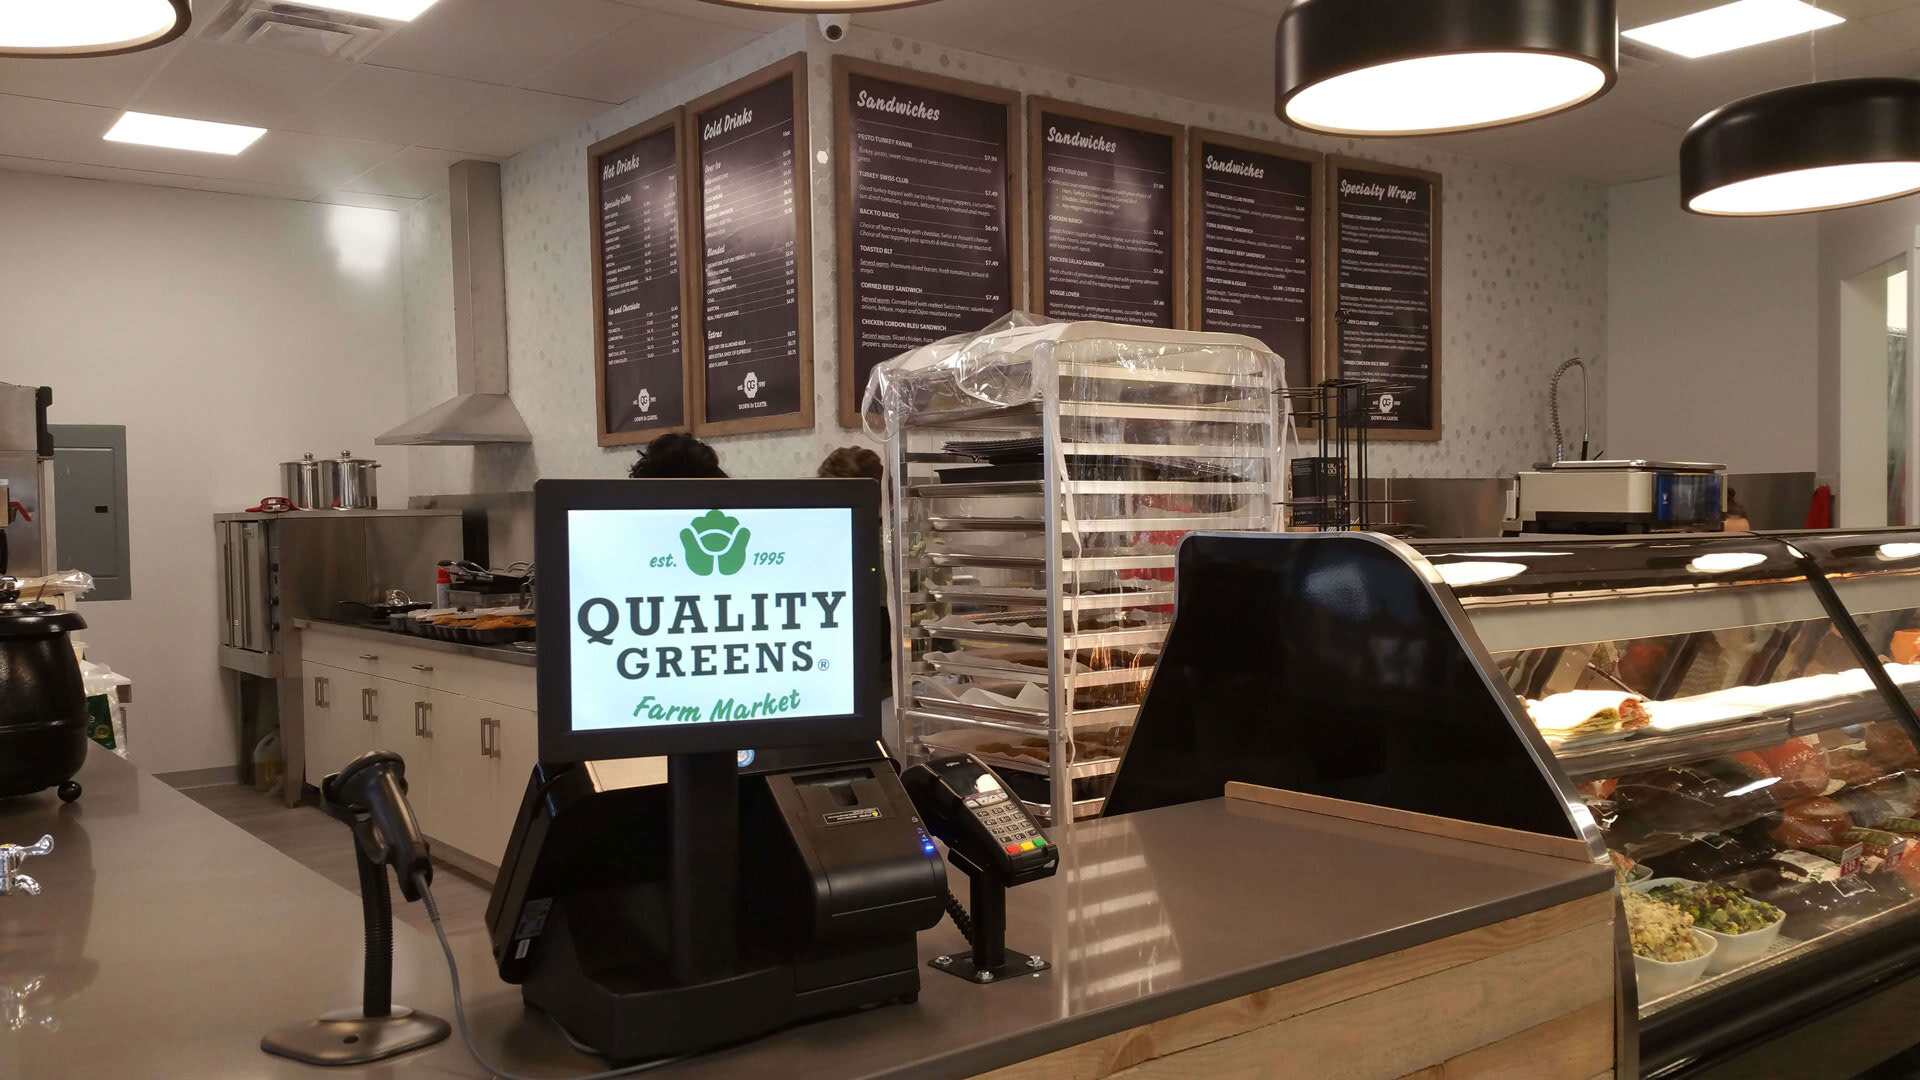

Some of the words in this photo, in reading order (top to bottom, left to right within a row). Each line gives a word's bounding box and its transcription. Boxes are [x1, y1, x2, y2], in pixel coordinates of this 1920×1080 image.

[857, 90, 940, 121] Sandwiches
[704, 118, 722, 141] Cold
[724, 108, 752, 133] Drinks
[858, 133, 875, 141] PESTO
[875, 136, 895, 144] TURKEY
[895, 140, 912, 148] PANINI
[1047, 126, 1117, 153] Sandwiches
[603, 164, 615, 180] Hot
[616, 154, 639, 175] Drinks
[1205, 155, 1264, 179] Sandwiches
[859, 170, 879, 179] TURKEY
[880, 174, 895, 182] SWISS
[895, 176, 909, 184] CLUB
[1340, 179, 1385, 201] Specialty
[1387, 185, 1416, 204] Wraps
[882, 211, 899, 219] BASICS
[707, 244, 725, 257] Blended
[860, 245, 883, 253] TOASTED
[861, 282, 882, 290] CORNED
[708, 330, 722, 339] Extras
[747, 380, 755, 391] QG
[1383, 398, 1391, 407] QG
[649, 553, 677, 568] est.
[753, 552, 785, 565] 1995
[577, 590, 846, 646] QUALITY
[617, 641, 813, 680] GREENS
[633, 695, 701, 723] Farm
[710, 689, 801, 722] Market
